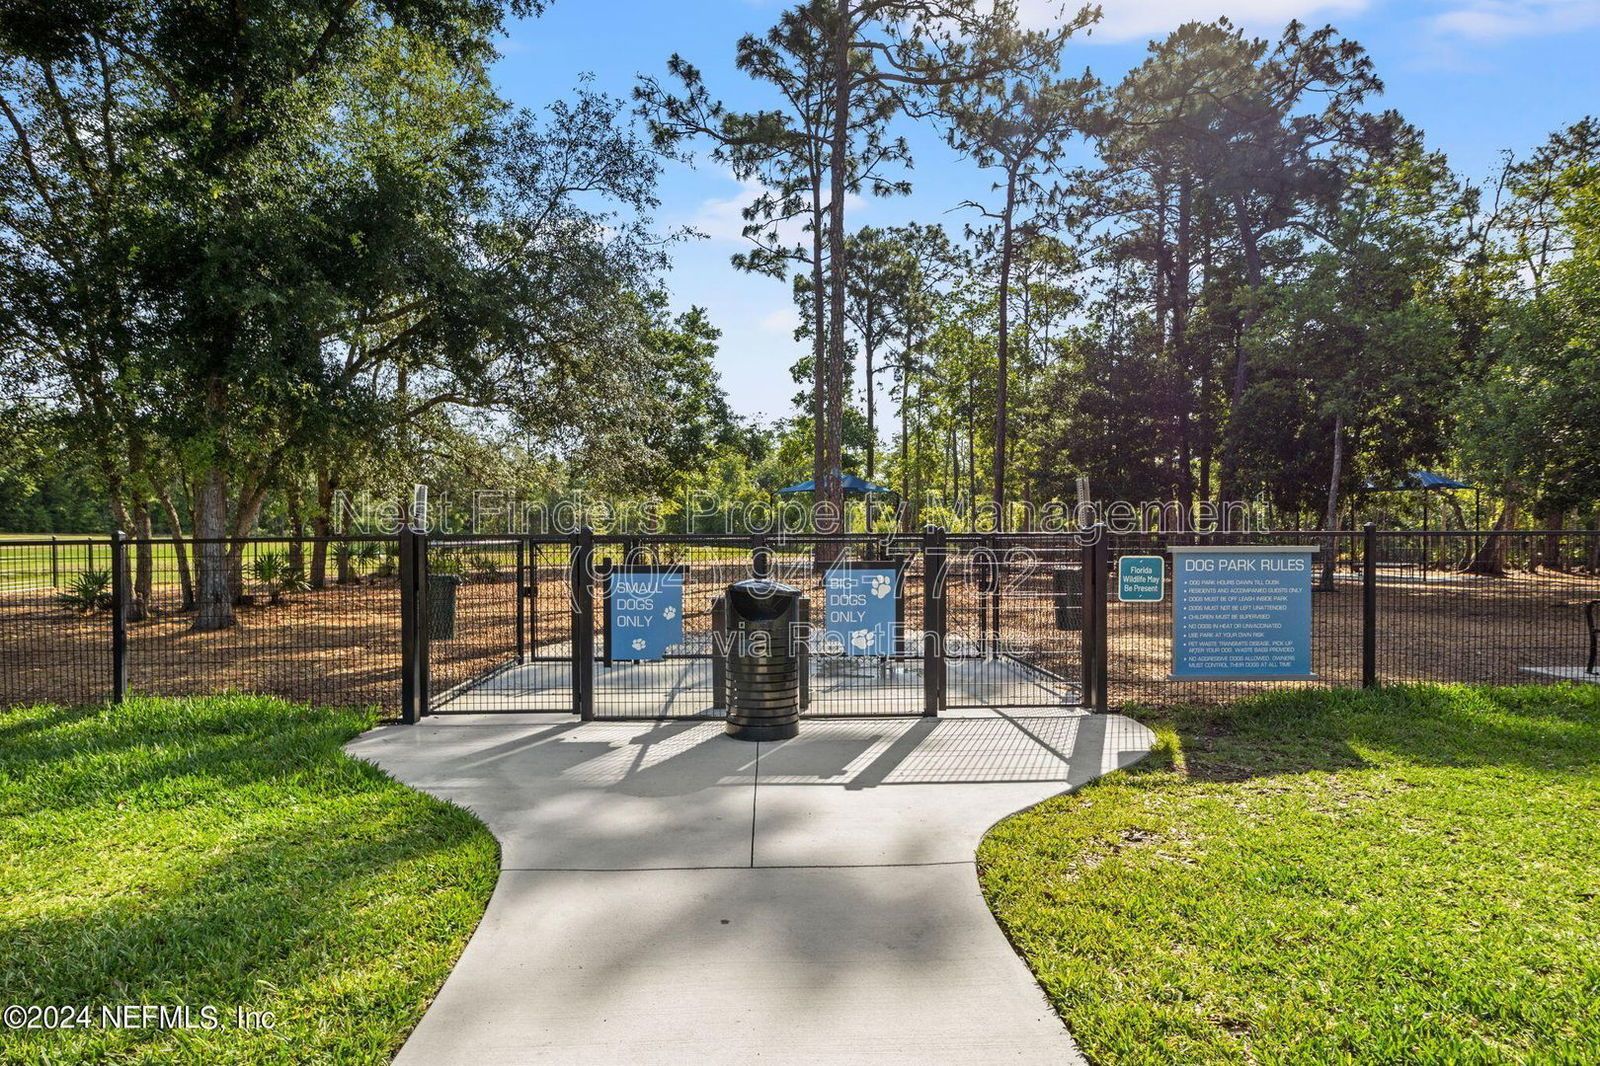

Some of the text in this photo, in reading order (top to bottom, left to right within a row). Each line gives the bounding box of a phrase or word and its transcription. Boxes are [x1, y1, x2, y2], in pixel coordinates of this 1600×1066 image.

[1186, 558, 1305, 572] DOG PARK RULES
[830, 578, 852, 590] BIG
[1147, 576, 1160, 584] May
[617, 582, 663, 593] SMALL
[617, 599, 654, 610] DOGS
[830, 594, 866, 606] DOGS
[617, 615, 653, 628] ONLY
[830, 611, 866, 623] ONLY
